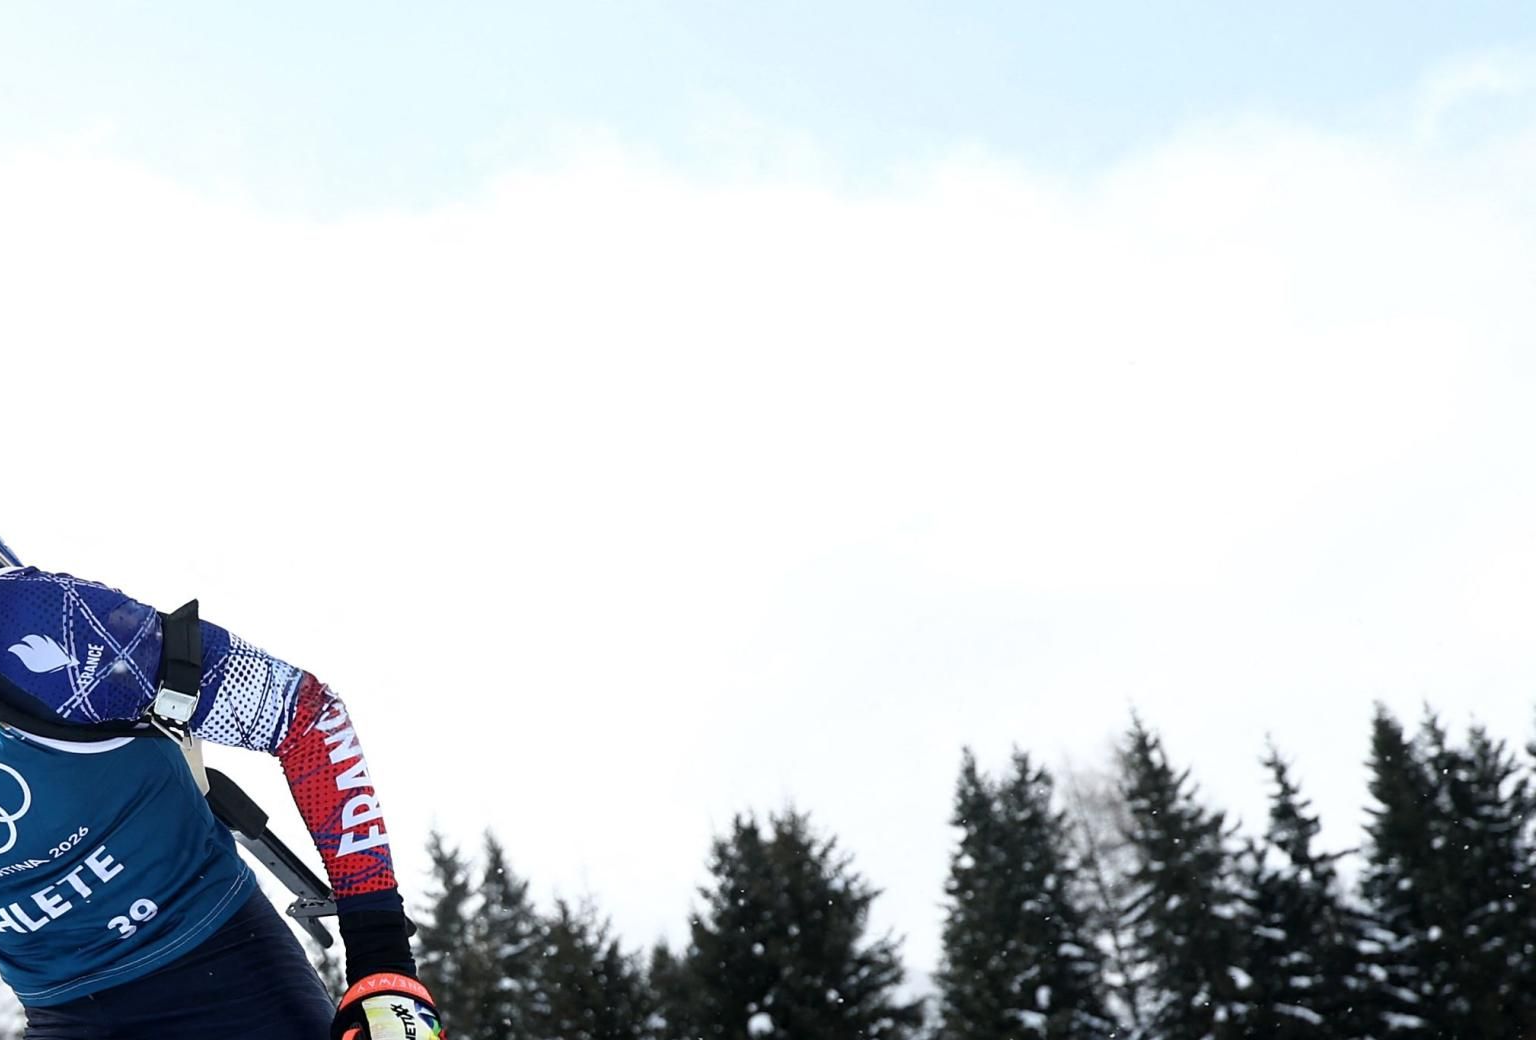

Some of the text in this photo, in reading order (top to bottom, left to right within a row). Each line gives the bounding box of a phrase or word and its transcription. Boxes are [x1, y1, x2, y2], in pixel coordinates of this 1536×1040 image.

[76, 643, 104, 688] FRANCE
[315, 702, 389, 858] FRANC
[49, 826, 89, 858] 2026
[107, 898, 158, 939] 39
